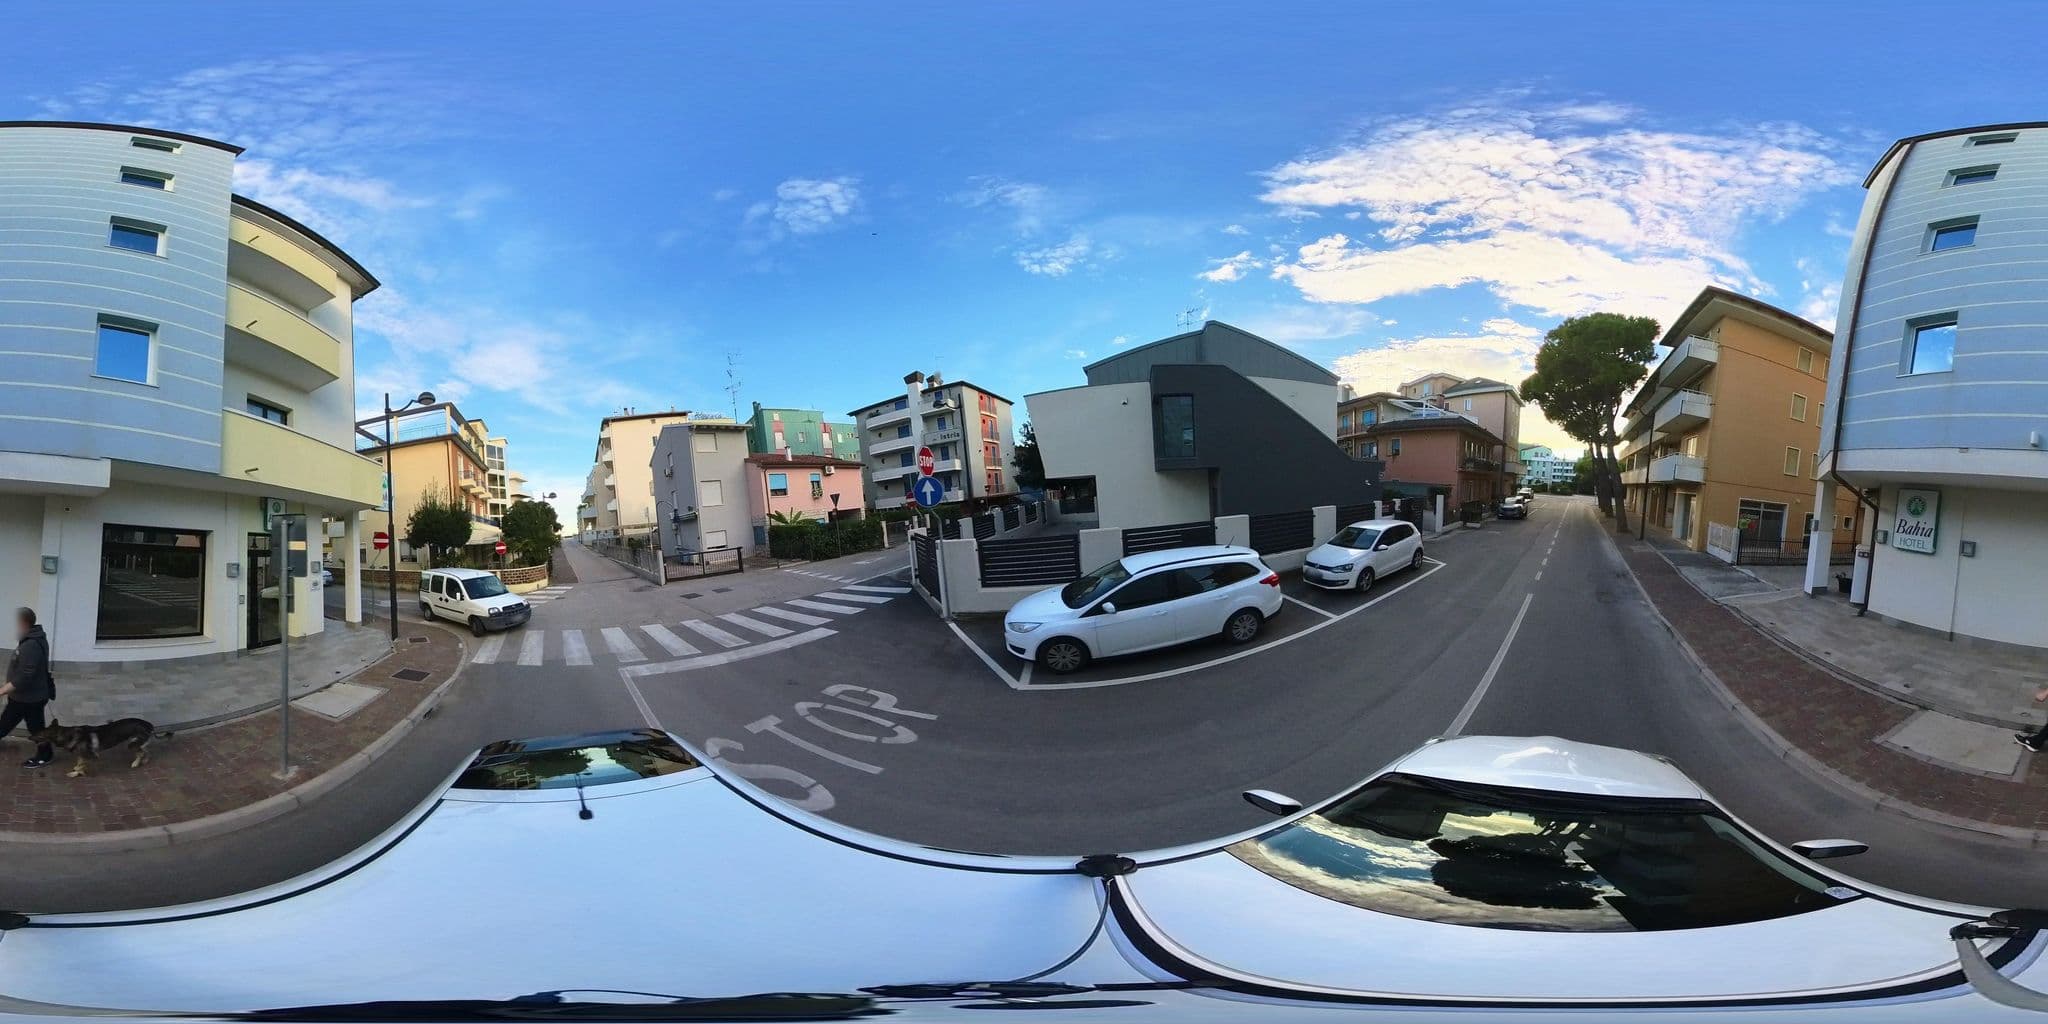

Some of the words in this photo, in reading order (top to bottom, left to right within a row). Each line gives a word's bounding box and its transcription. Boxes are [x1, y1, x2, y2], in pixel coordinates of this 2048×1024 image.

[919, 456, 933, 467] STOP
[1896, 519, 1934, 537] Bahia
[1899, 537, 1929, 550] HOTEL
[706, 684, 938, 812] STOP
